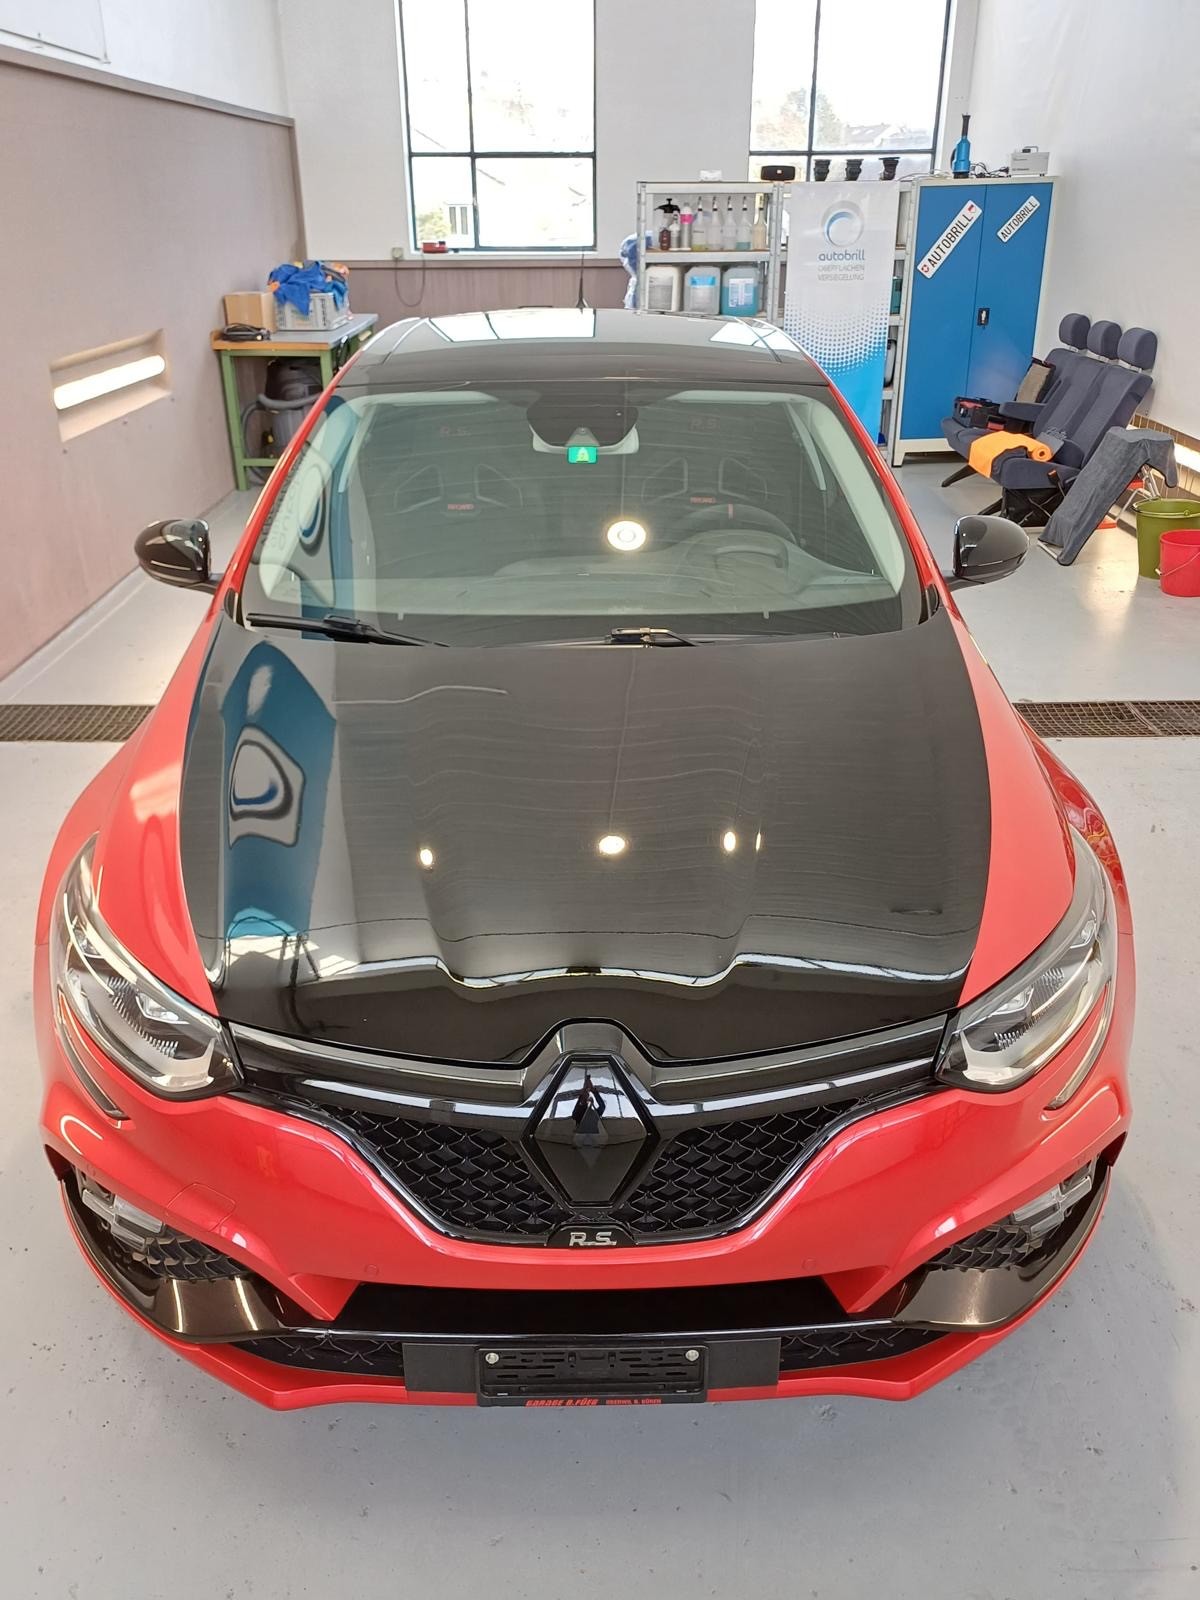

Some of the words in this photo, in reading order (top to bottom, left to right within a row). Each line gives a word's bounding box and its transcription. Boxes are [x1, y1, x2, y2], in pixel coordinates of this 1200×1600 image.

[1000, 200, 1038, 240] AUTOBRILL
[818, 249, 865, 262] autobrill
[927, 213, 974, 268] AUTOBRILL
